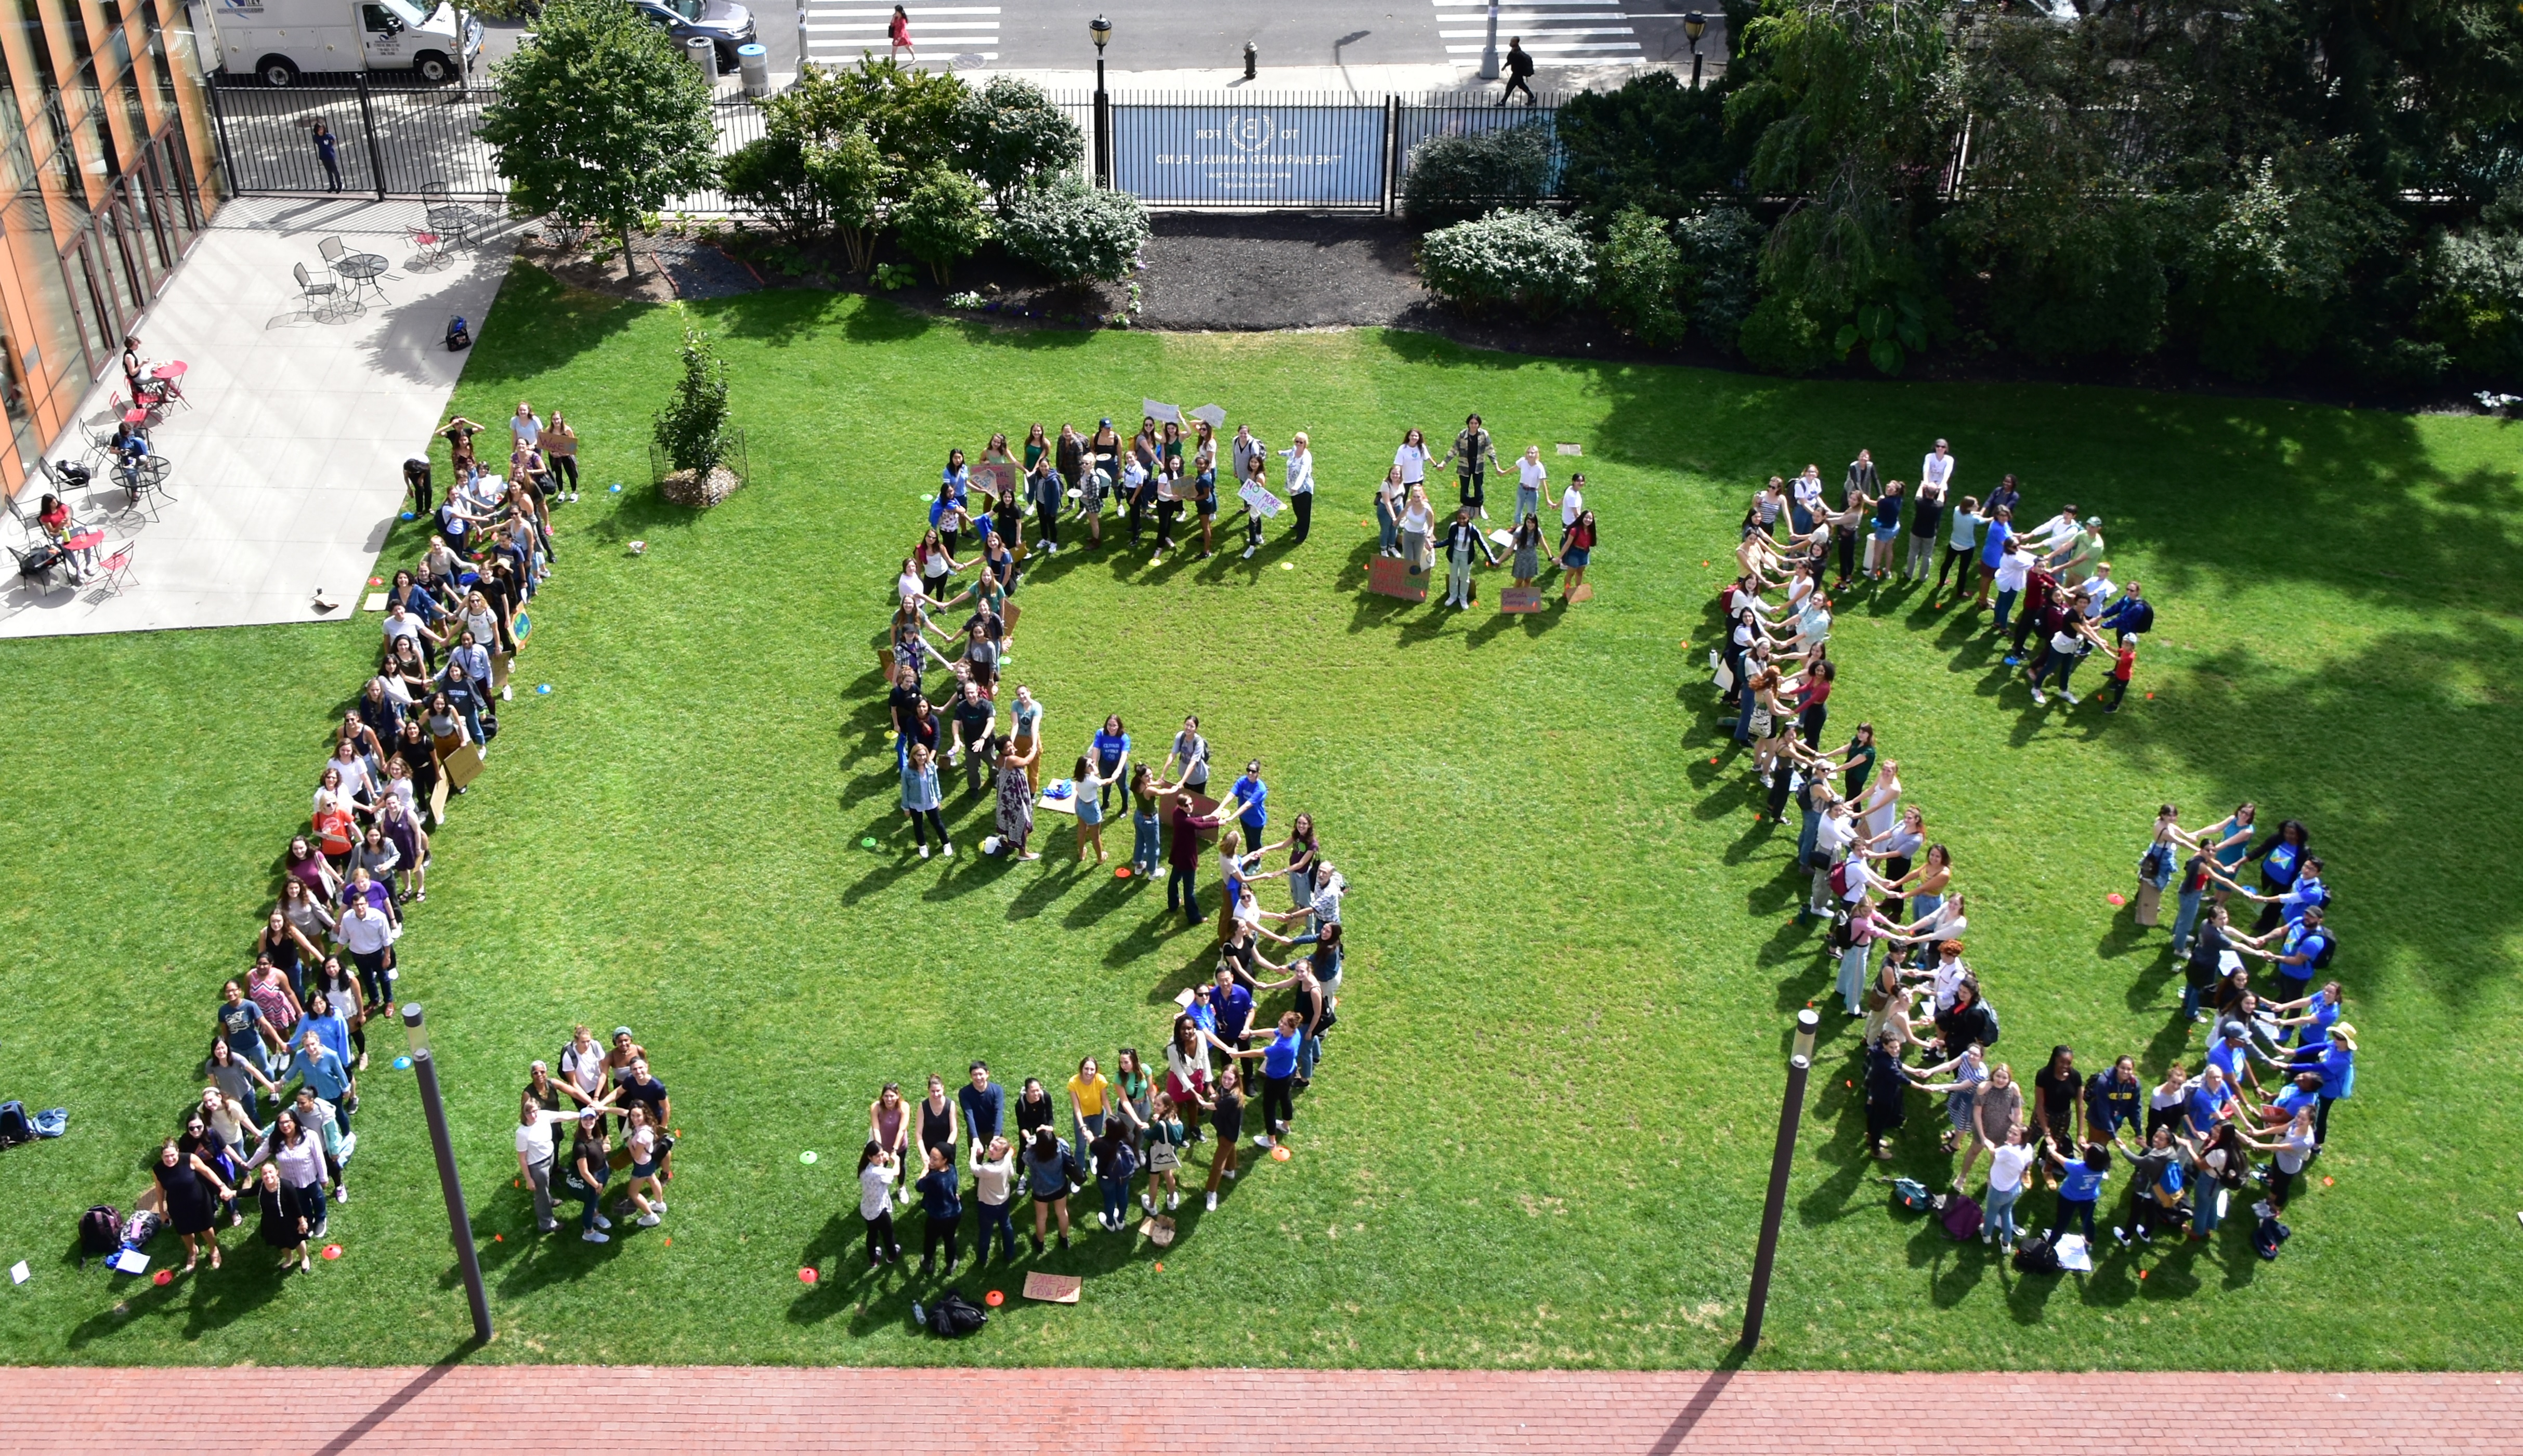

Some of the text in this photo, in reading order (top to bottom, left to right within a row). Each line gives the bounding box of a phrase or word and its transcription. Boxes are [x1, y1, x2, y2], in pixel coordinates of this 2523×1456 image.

[539, 435, 565, 451] WAKE
[1240, 487, 1262, 507] FOSSIL
[1246, 480, 1282, 510] NO MORE
[1375, 559, 1405, 574] MAKE
